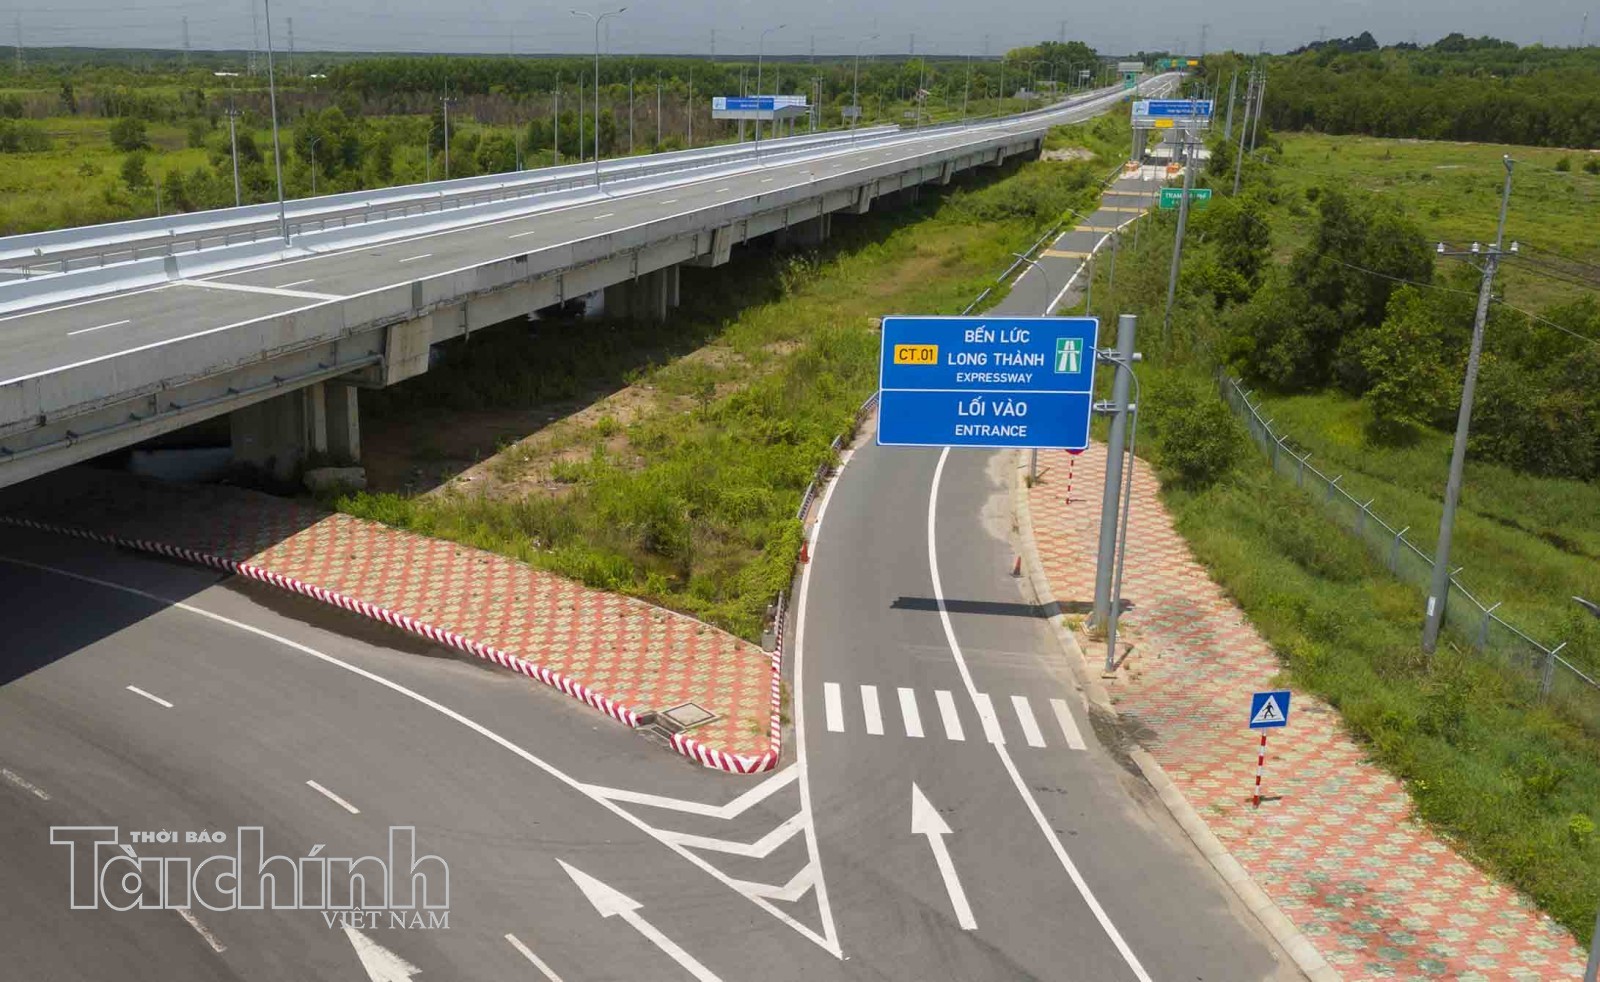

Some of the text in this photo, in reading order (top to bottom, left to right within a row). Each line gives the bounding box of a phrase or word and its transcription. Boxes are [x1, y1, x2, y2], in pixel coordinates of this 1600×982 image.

[964, 325, 1030, 343] BẾN LỨC
[899, 348, 933, 361] CT.01
[948, 350, 1045, 366] LONG THÀNH
[956, 372, 1033, 383] EXPRESSWAY
[958, 395, 1027, 417] LỐI VÀO
[955, 424, 1028, 437] ENTRANCE
